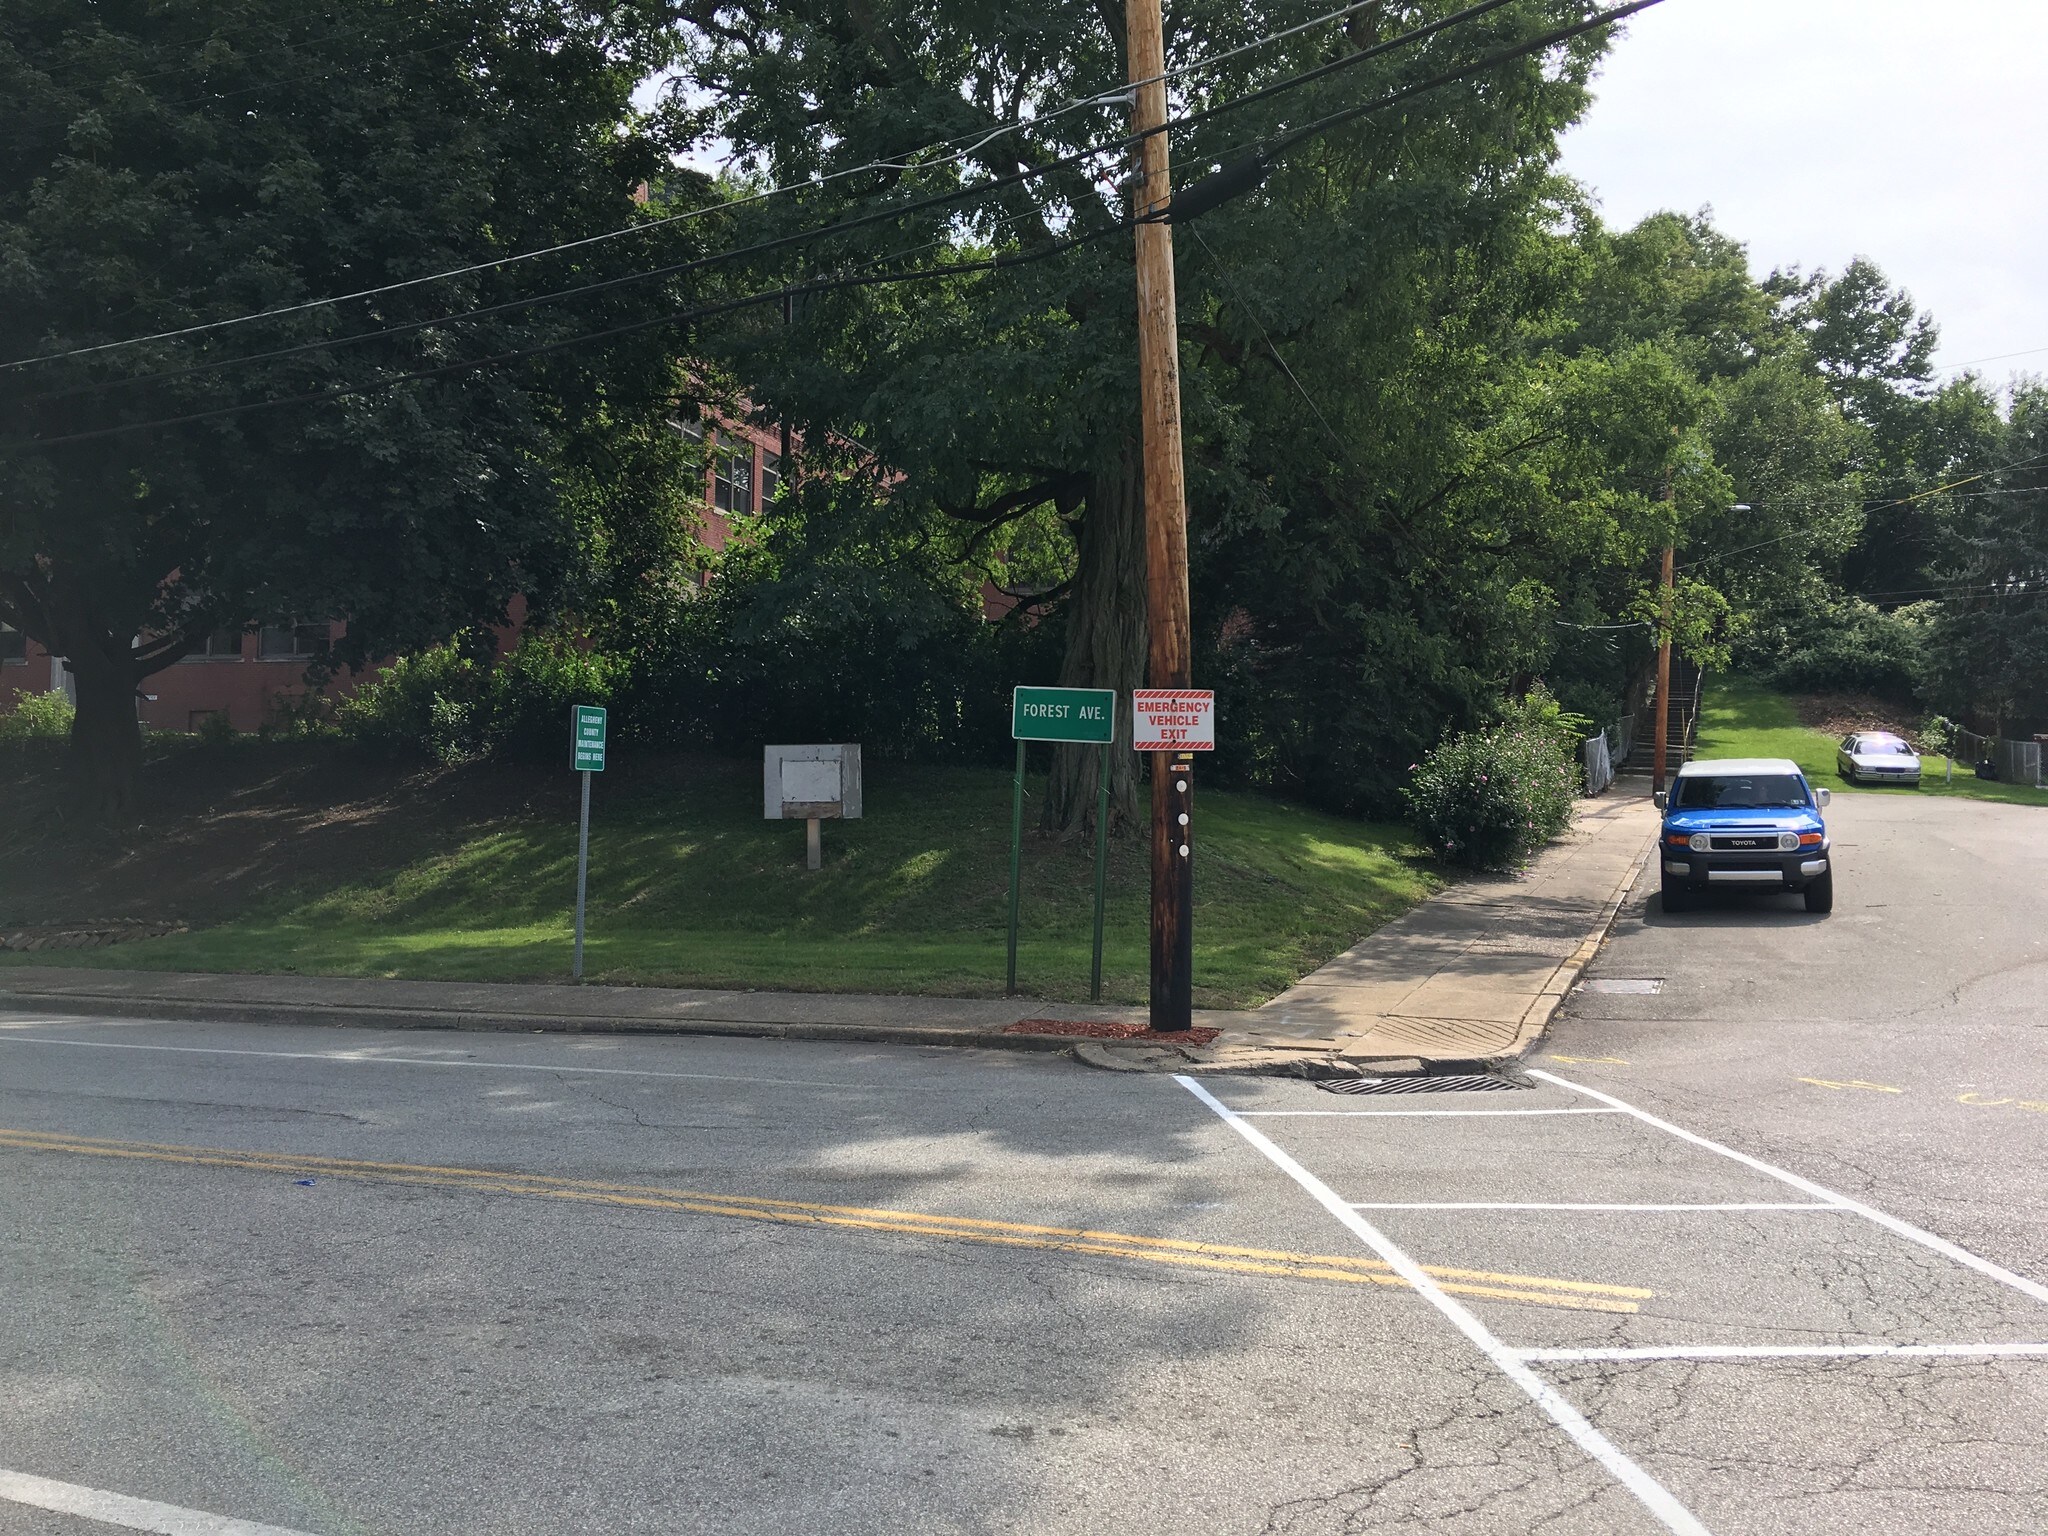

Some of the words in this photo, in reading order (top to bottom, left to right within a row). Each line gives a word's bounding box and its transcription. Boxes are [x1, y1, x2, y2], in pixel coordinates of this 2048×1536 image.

[1023, 703, 1070, 718] FOREST
[1078, 706, 1105, 720] AVE.
[1137, 702, 1210, 712] EMERGENCY
[1149, 715, 1199, 725] VEHICLE
[583, 728, 599, 736] COUNTY
[1160, 729, 1188, 740] EXIT
